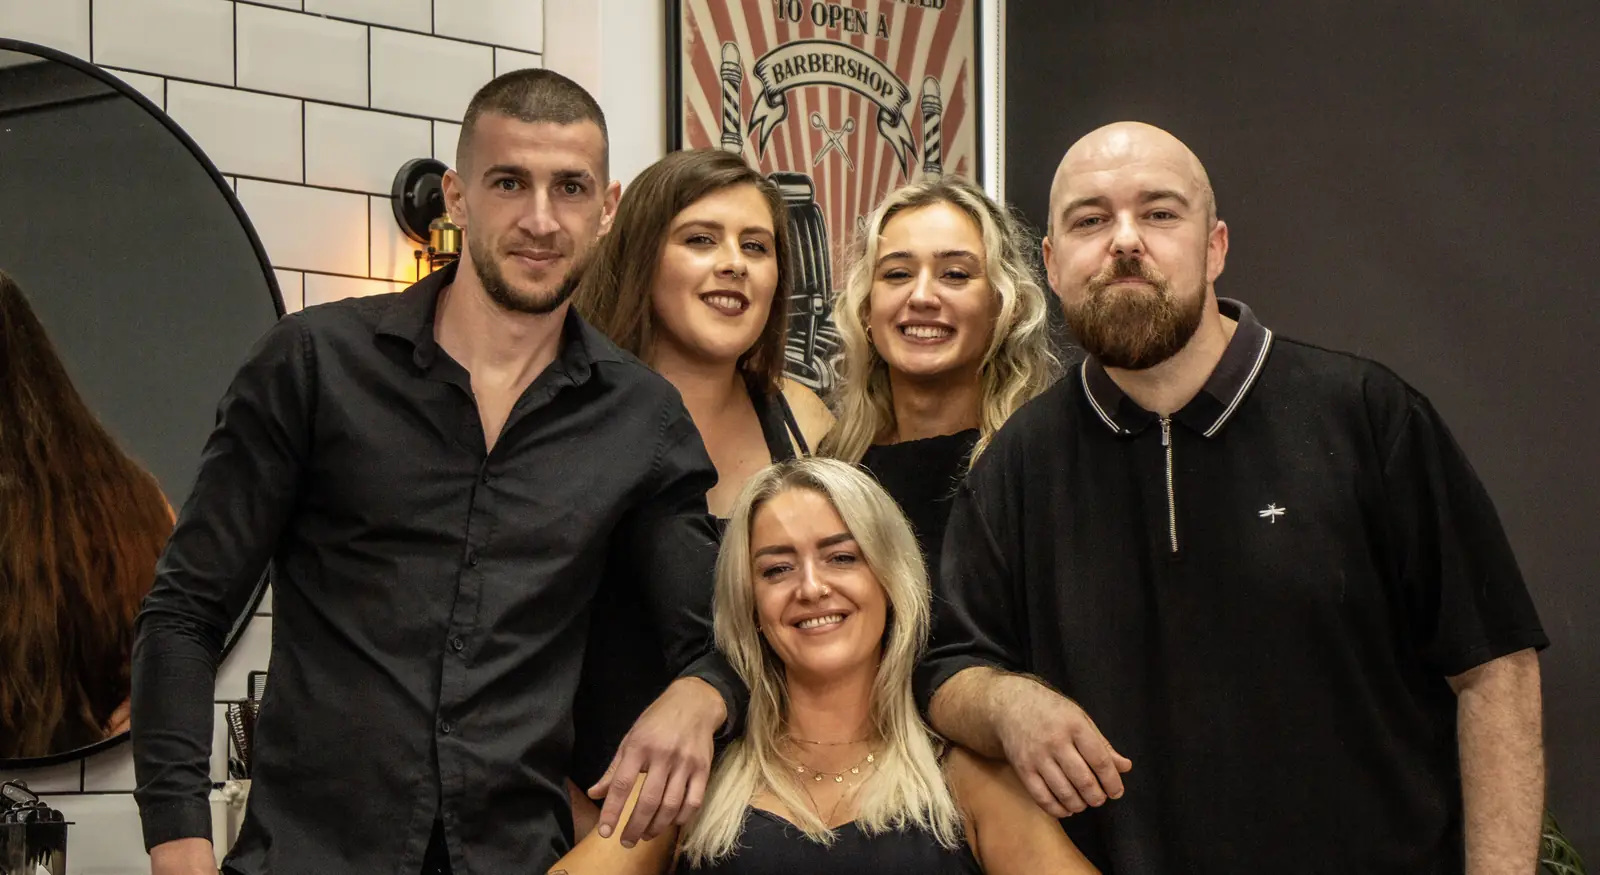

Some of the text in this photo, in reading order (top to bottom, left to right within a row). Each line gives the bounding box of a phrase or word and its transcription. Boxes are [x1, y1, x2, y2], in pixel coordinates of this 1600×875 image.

[775, 0, 803, 22] TO
[811, 2, 868, 34] OPEN
[876, 14, 888, 38] A
[772, 53, 894, 97] BARBERSHOP
